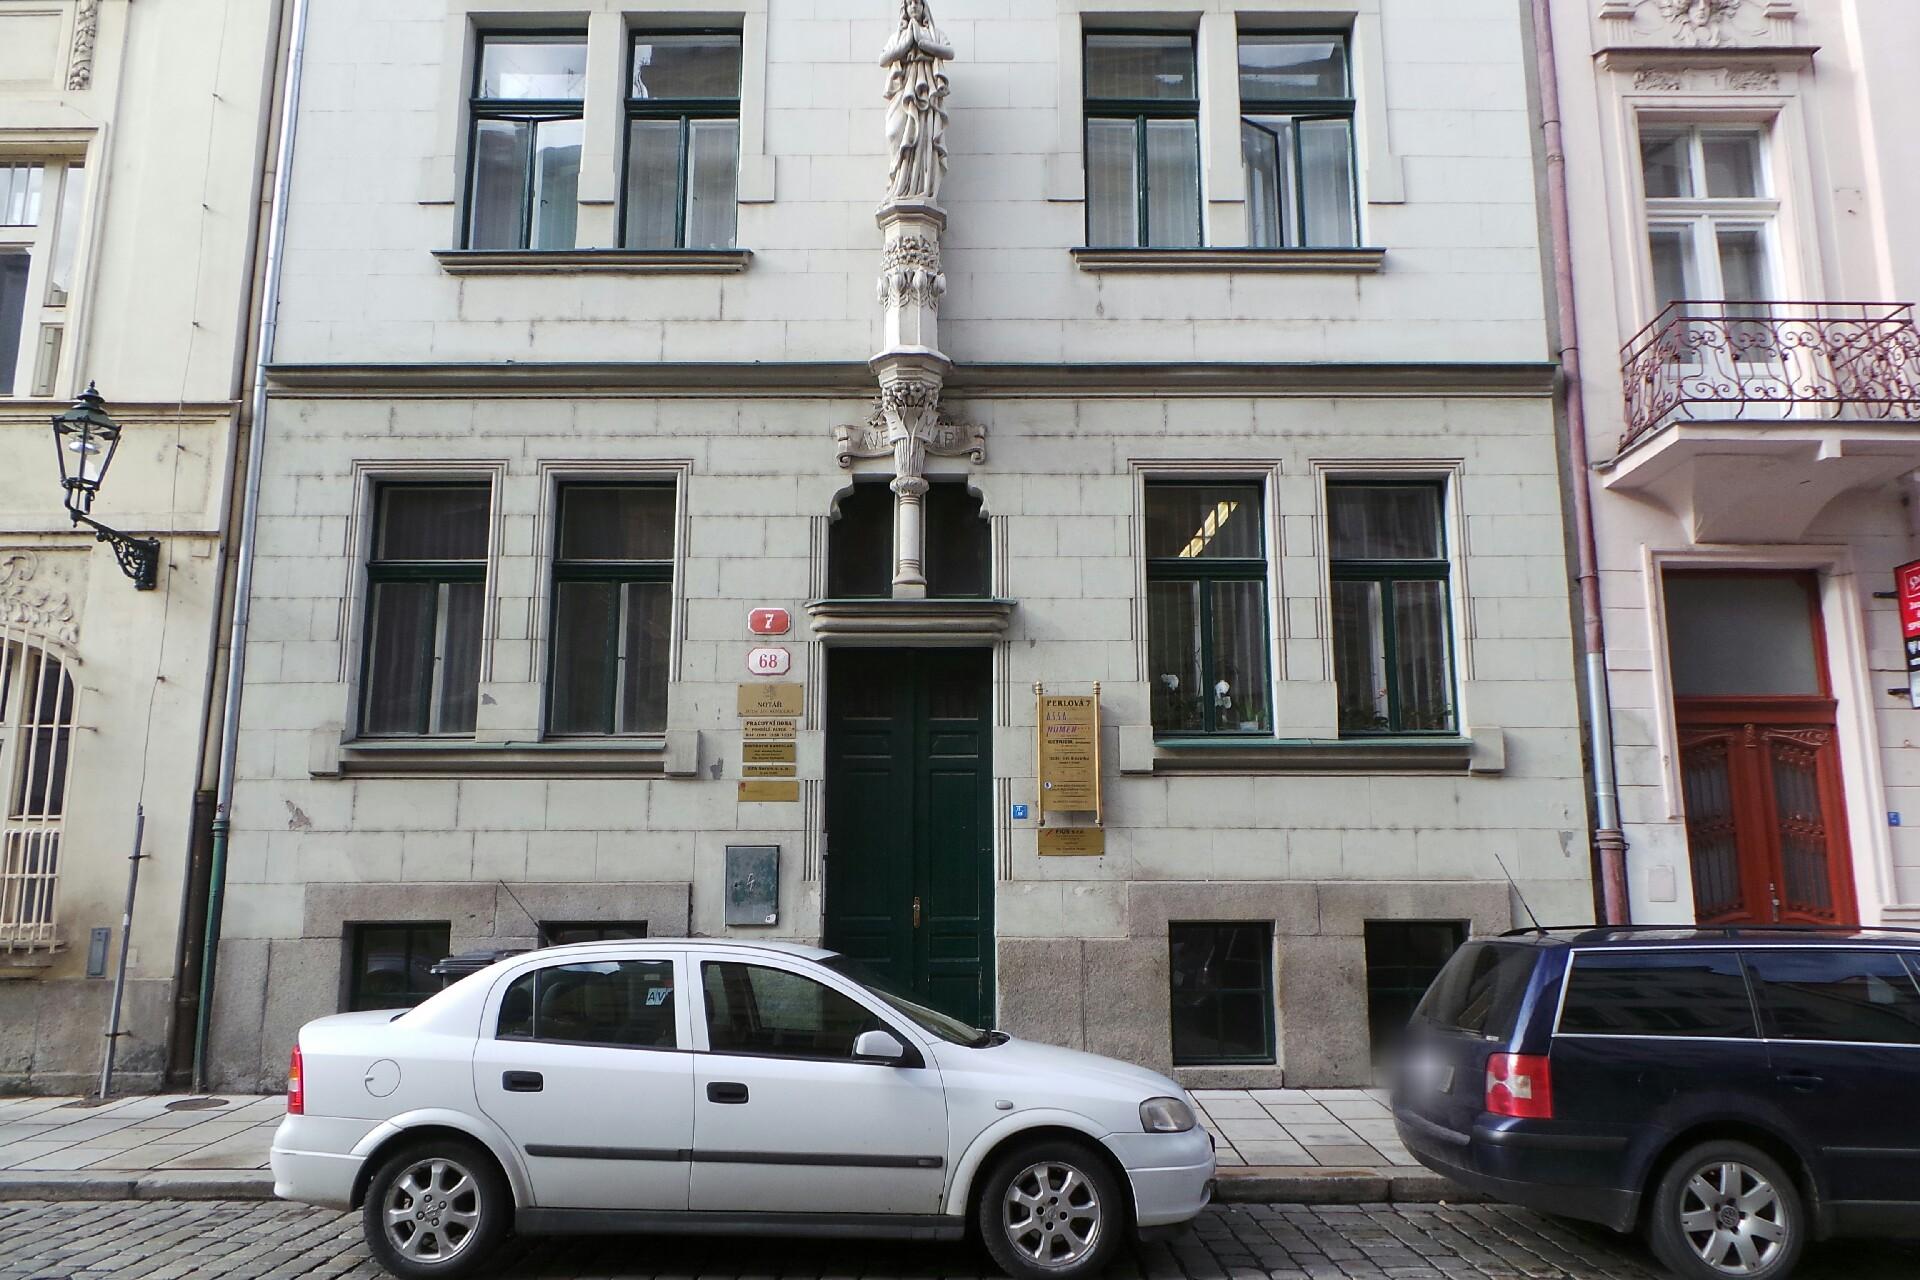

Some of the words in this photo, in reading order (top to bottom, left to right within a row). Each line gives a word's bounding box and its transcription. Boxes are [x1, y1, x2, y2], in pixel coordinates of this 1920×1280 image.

[765, 613, 774, 629] 7
[759, 654, 778, 668] 68
[1047, 698, 1084, 707] PERLOVÁ
[1086, 699, 1091, 707] 7
